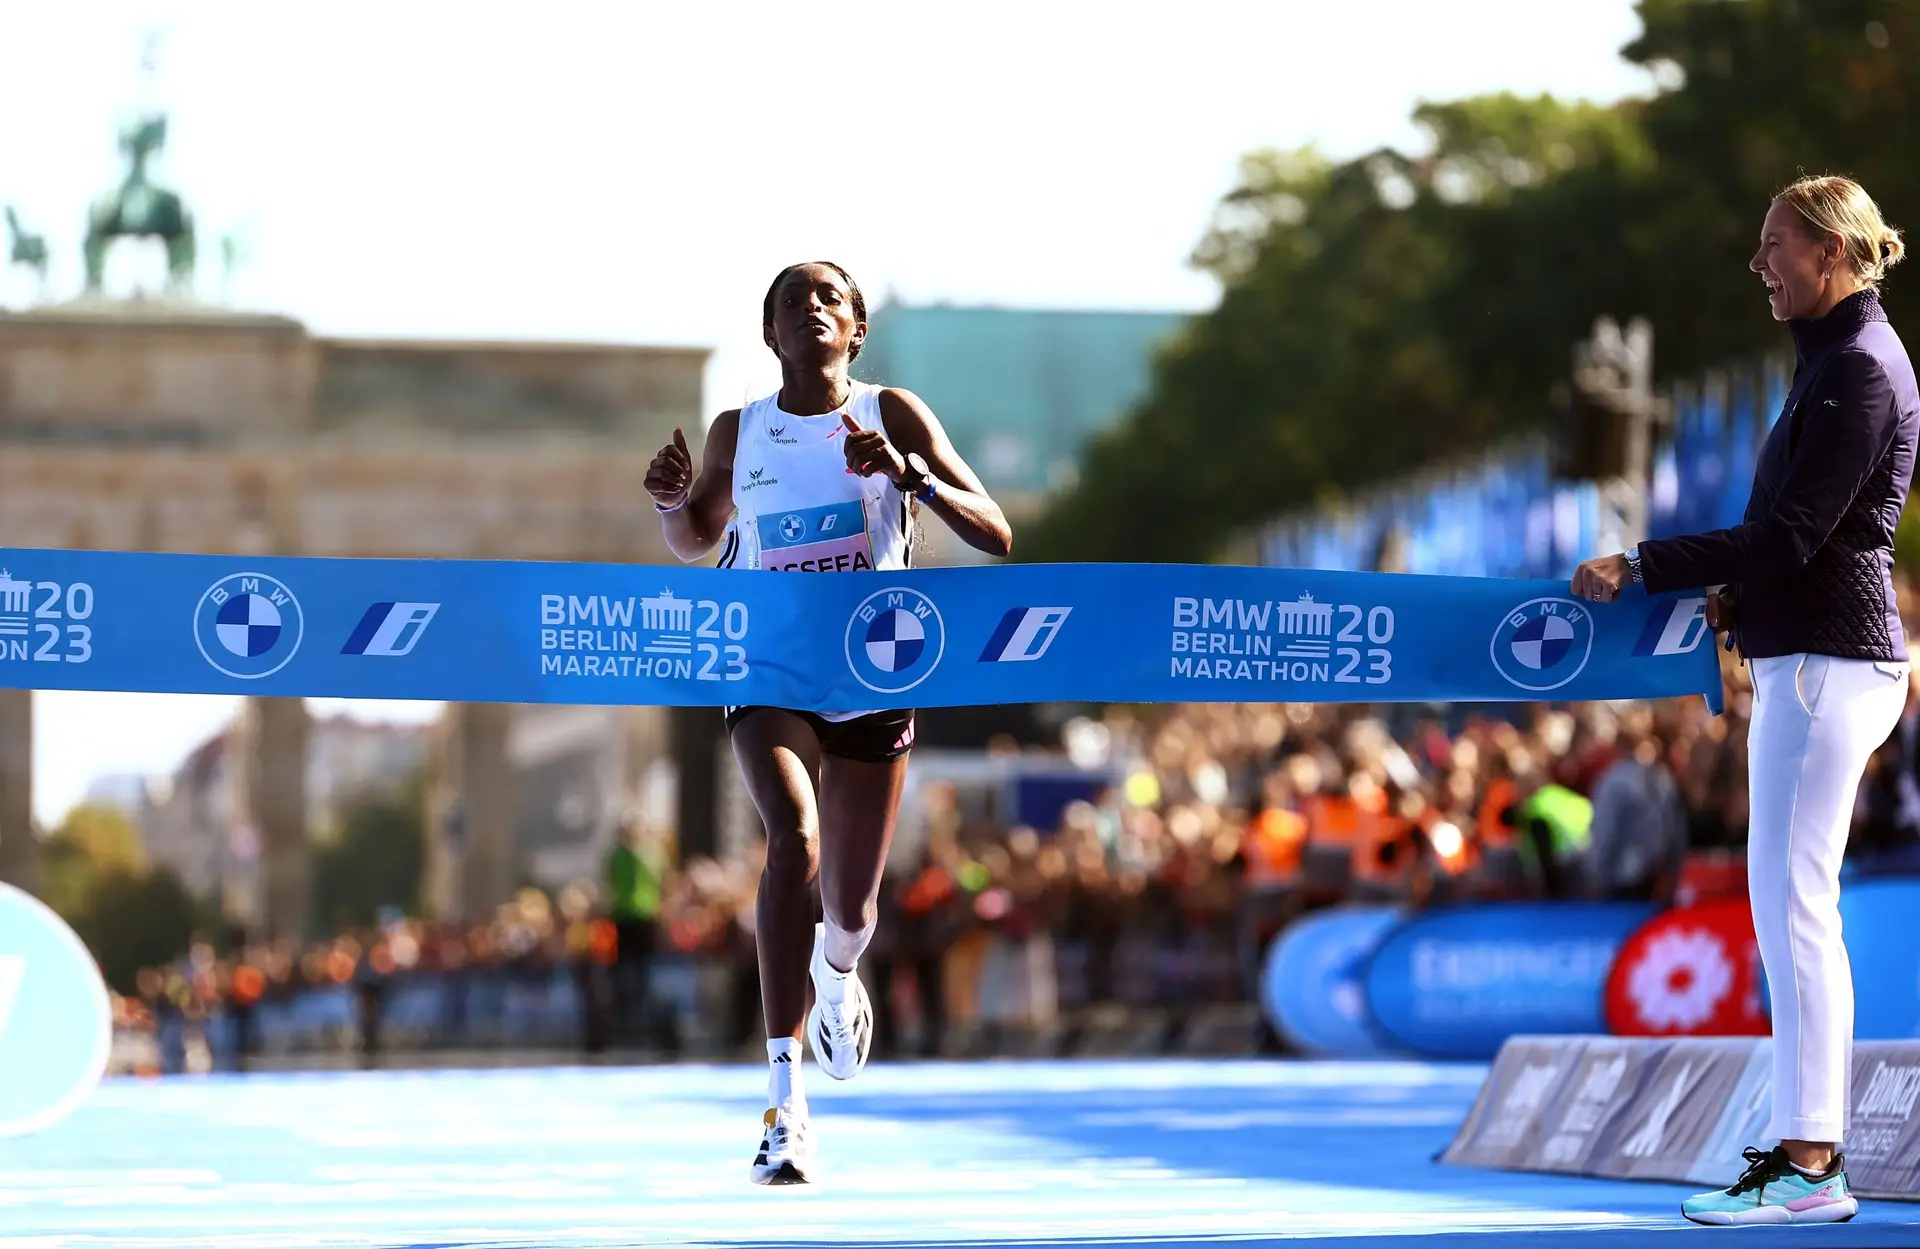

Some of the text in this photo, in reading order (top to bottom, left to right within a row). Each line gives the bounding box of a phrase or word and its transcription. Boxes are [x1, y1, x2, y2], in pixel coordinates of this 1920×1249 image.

[756, 477, 778, 487] Angels
[769, 551, 871, 572] SEFA
[35, 582, 94, 620] 20
[211, 578, 290, 607] BMW
[541, 594, 636, 627] BMW
[696, 600, 749, 640] 20
[859, 593, 932, 623] BMW
[1173, 597, 1272, 631] BMW
[1510, 602, 1583, 629] BMW
[1336, 605, 1395, 644] 20
[34, 623, 92, 663] 23
[541, 629, 637, 651] BERLIN
[1172, 631, 1272, 656] BERLIN
[541, 654, 692, 679] MARATHON
[696, 643, 750, 681] 23
[1171, 657, 1329, 682] MARATHON
[1334, 648, 1392, 684] 23
